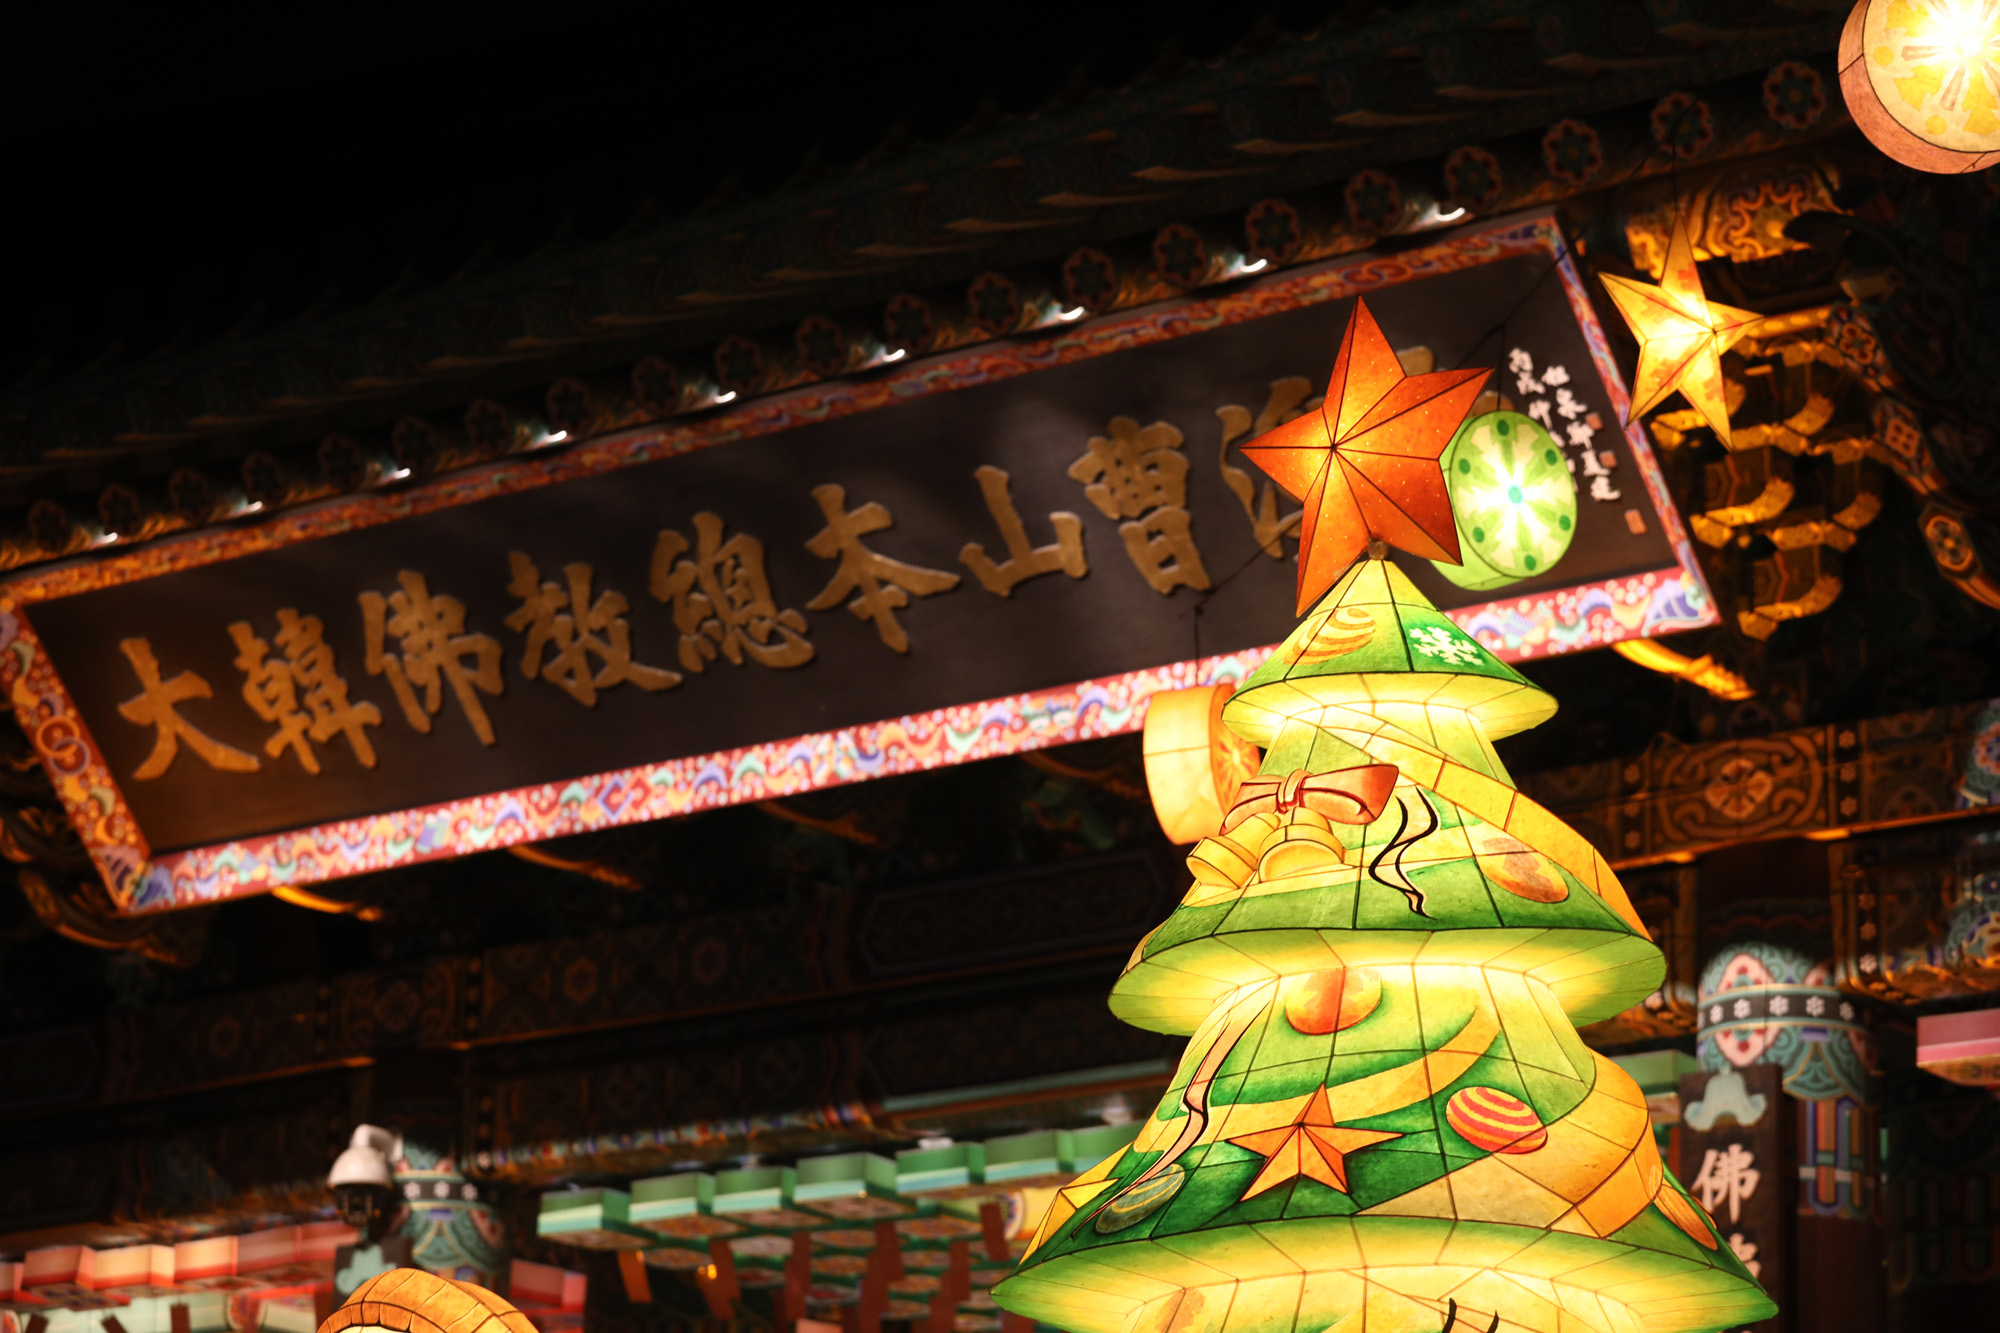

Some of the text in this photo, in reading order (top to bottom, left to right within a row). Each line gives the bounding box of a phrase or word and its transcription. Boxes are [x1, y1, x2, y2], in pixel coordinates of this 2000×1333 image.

[118, 345, 1515, 781] 大韓佛教總本山曹
